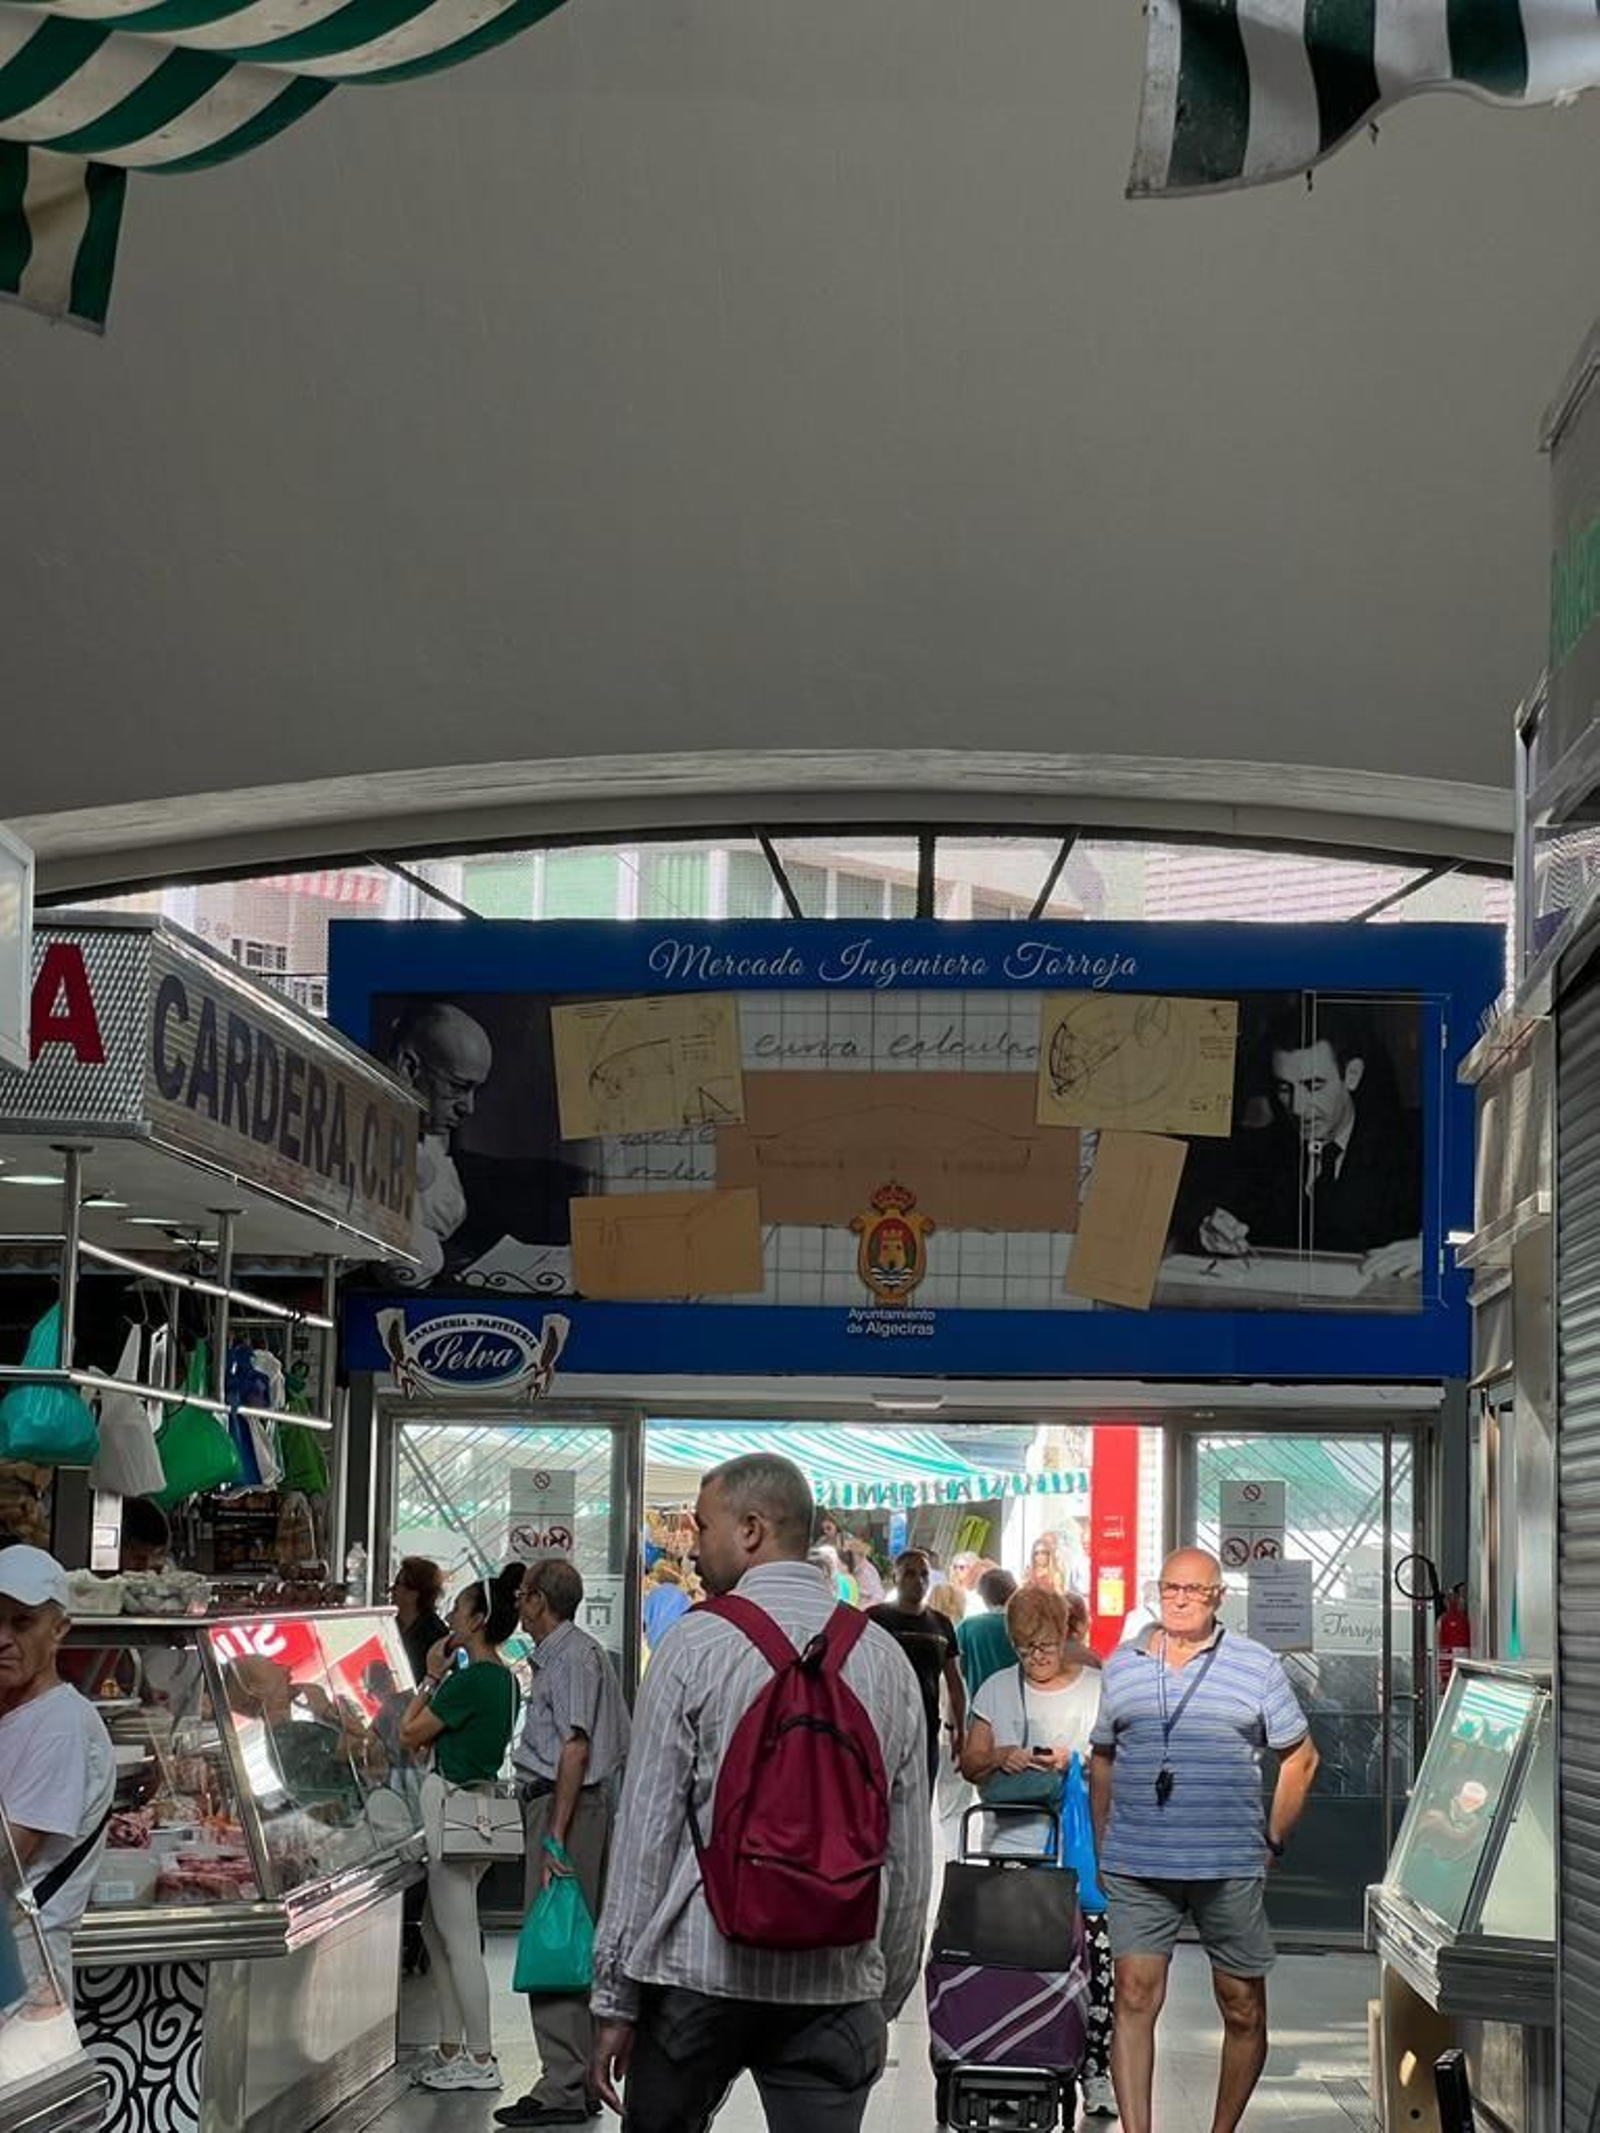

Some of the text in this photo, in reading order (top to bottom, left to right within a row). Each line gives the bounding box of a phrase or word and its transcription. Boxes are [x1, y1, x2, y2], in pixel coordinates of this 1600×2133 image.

[649, 938, 1137, 988] Mercado Ingeniero Torroja
[848, 1307, 936, 1322] Ayuntamiento
[846, 1320, 935, 1337] de Algeciras
[424, 1334, 517, 1372] Selva
